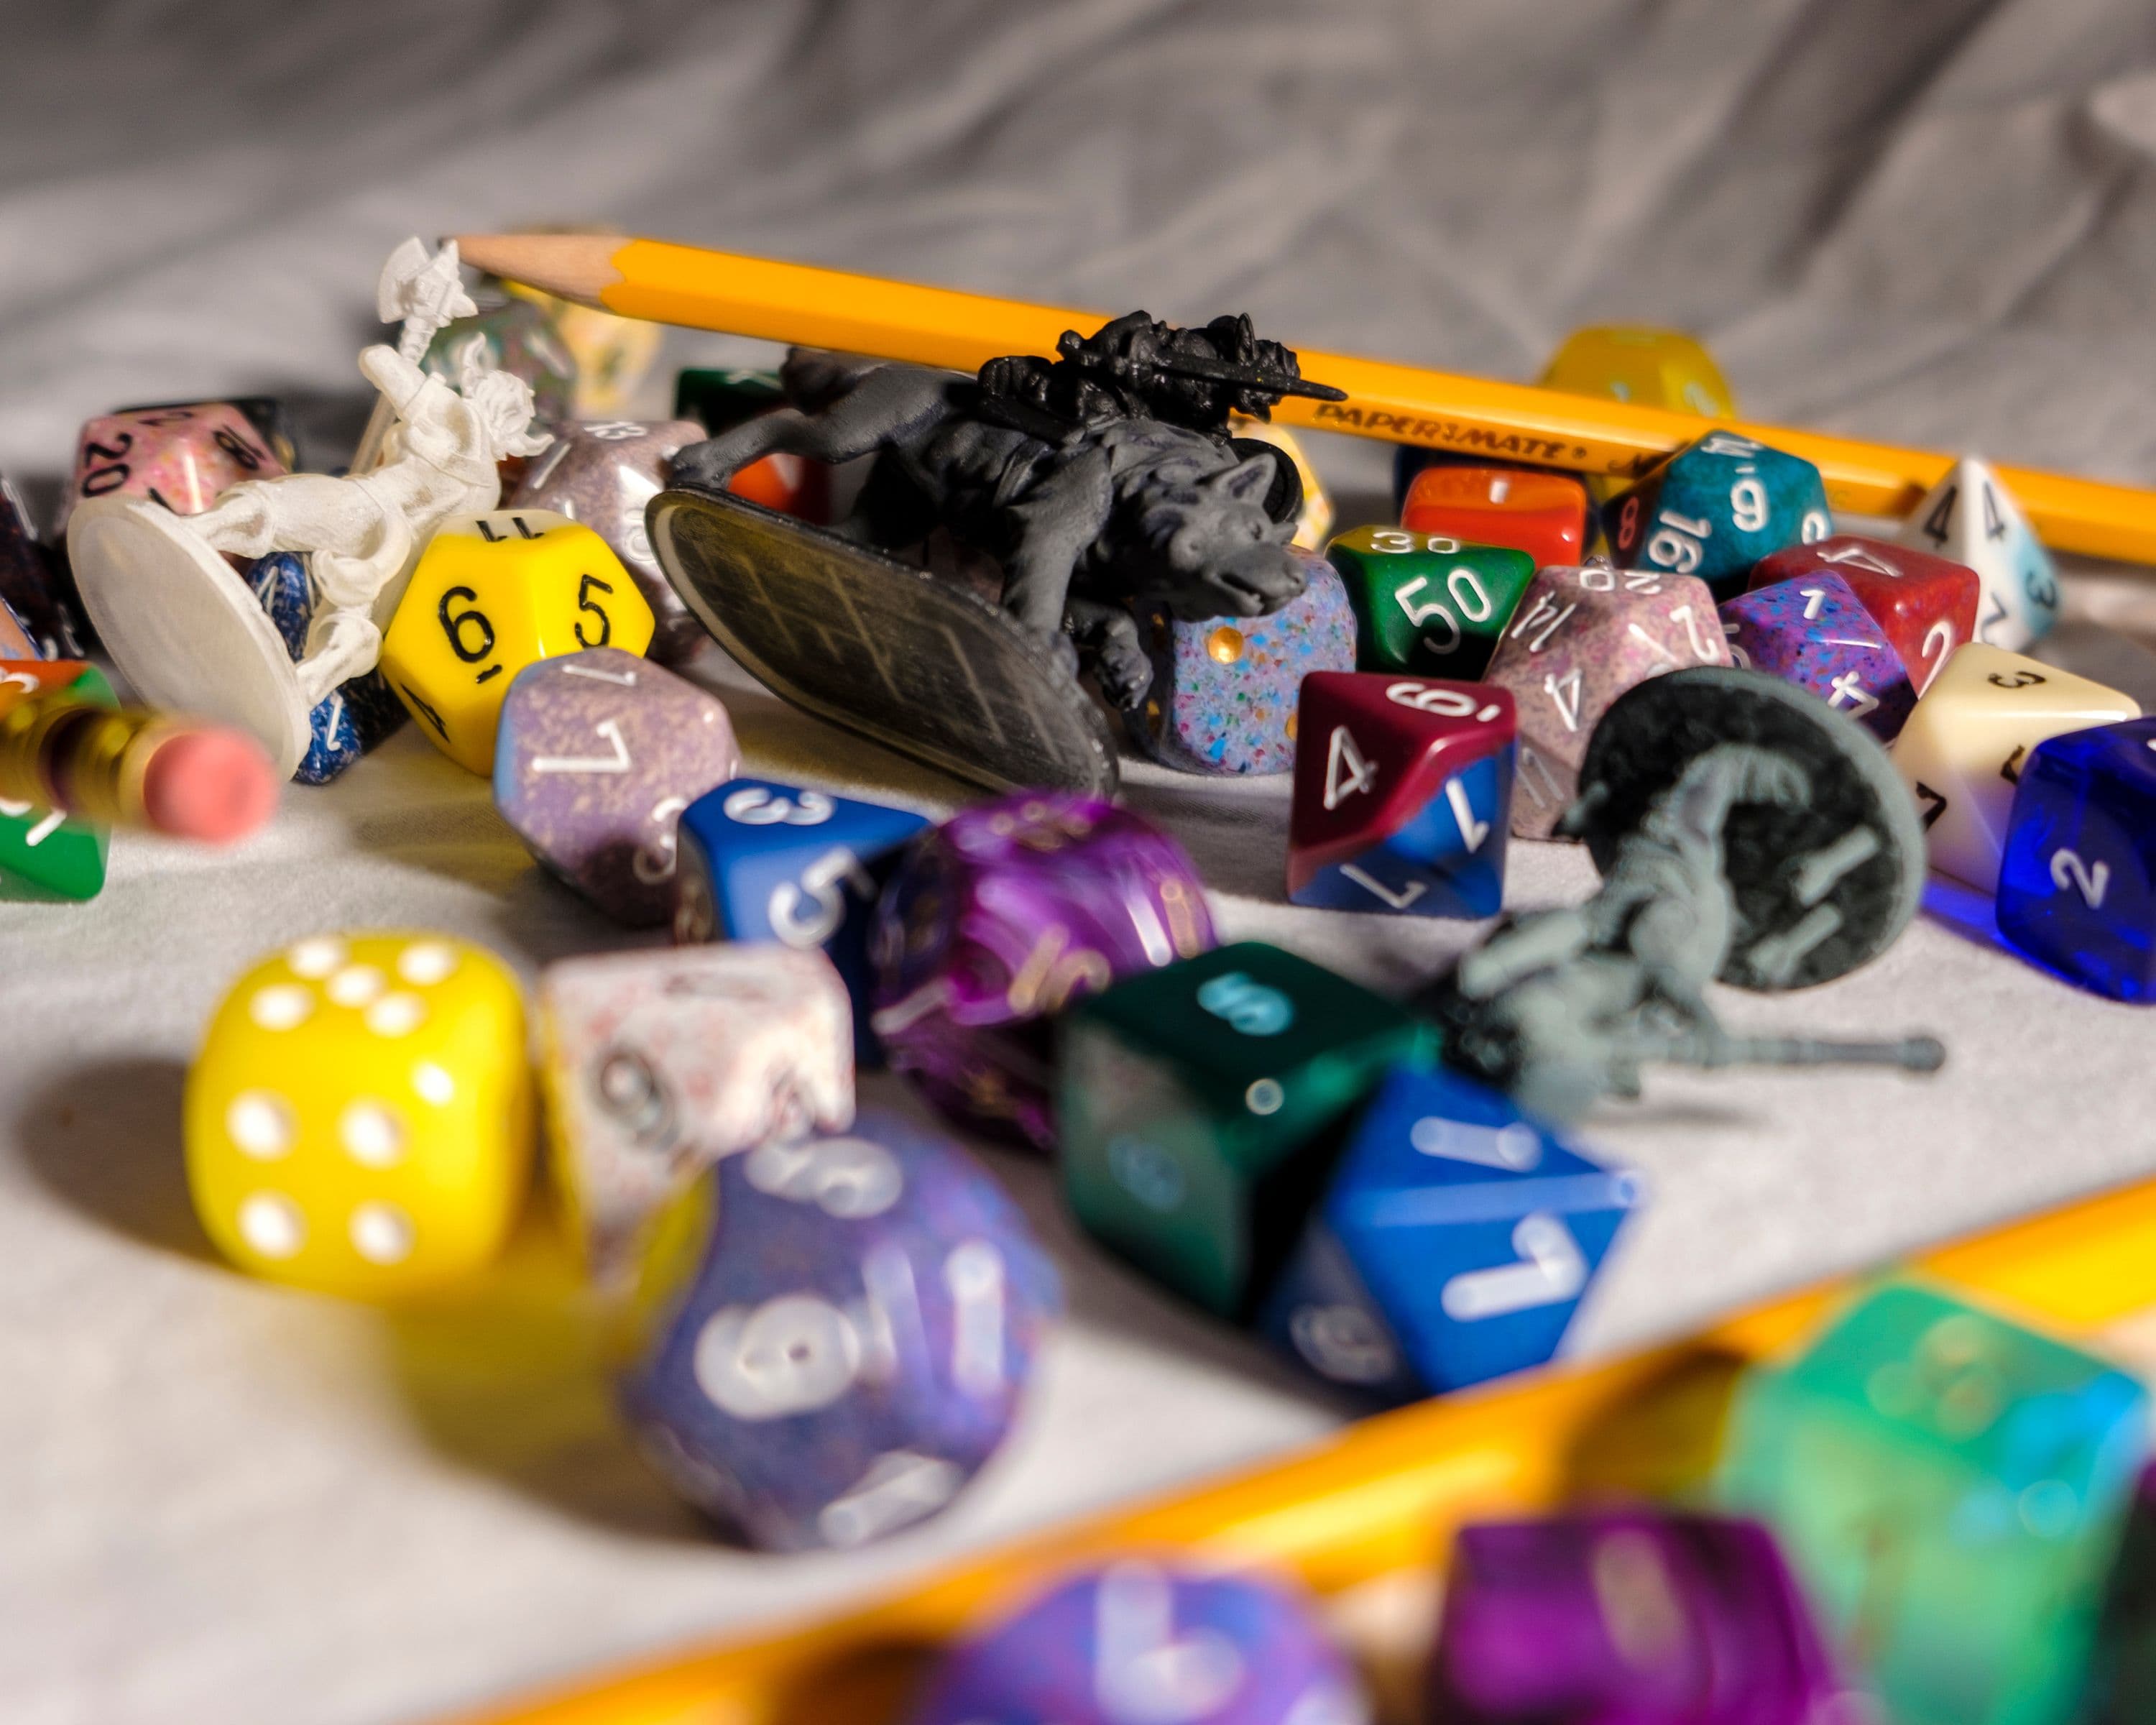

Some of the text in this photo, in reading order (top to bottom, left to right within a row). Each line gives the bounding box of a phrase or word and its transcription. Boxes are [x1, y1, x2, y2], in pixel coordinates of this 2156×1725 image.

[1648, 510, 1712, 574] 16
[574, 574, 613, 648] 5
[1393, 568, 1493, 656] 50
[1322, 723, 1380, 811] 4
[768, 845, 875, 950] 5
[2048, 847, 2110, 910] 2
